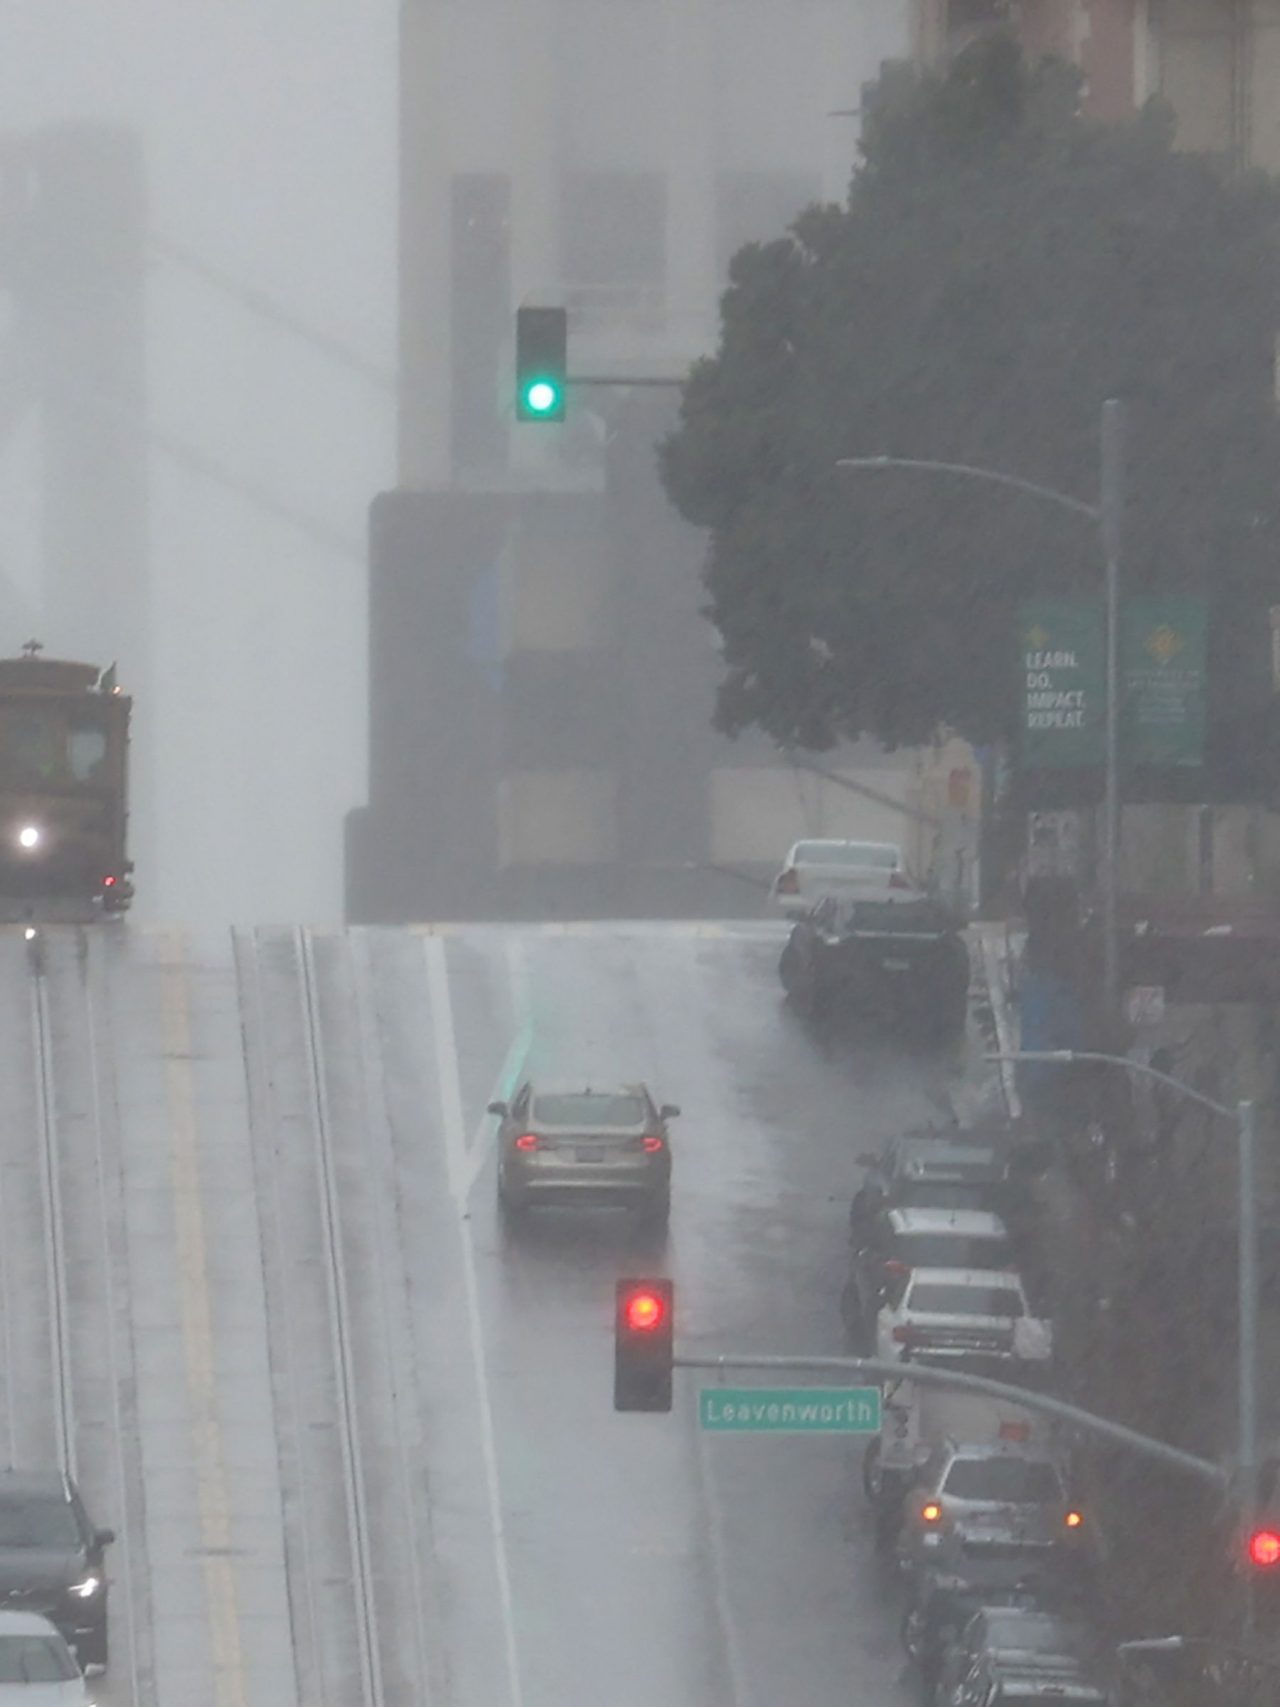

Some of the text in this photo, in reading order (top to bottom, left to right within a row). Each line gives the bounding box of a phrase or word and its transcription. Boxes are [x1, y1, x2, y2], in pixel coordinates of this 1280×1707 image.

[1026, 651, 1079, 669] LEARN.
[1026, 671, 1053, 690] DO.
[707, 1399, 871, 1424] Leavenworth
